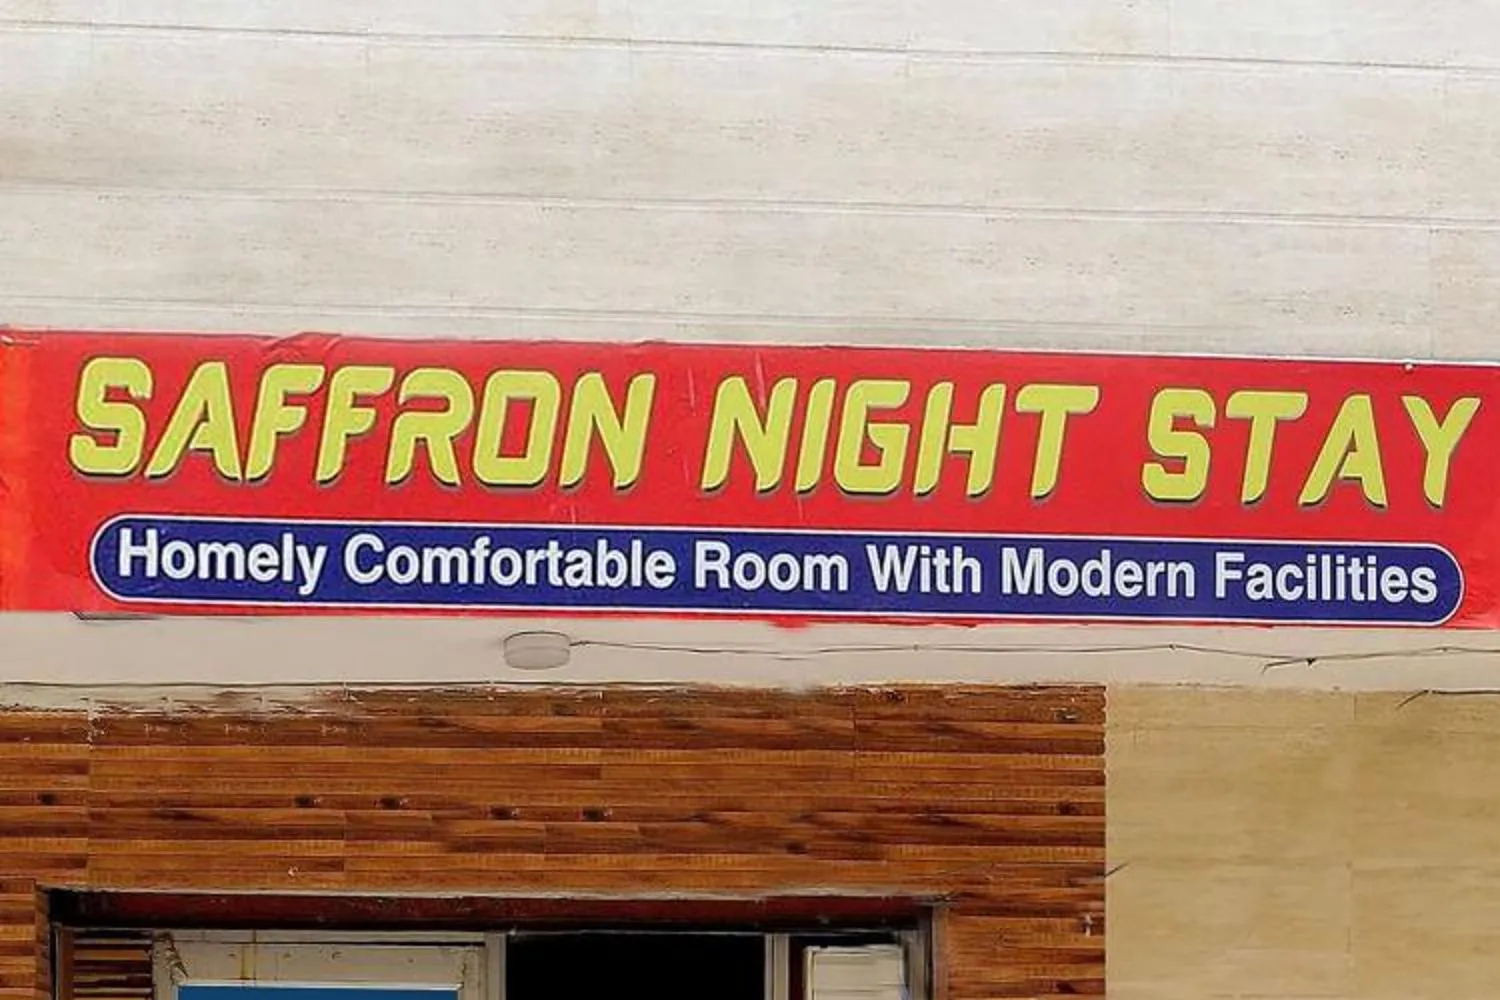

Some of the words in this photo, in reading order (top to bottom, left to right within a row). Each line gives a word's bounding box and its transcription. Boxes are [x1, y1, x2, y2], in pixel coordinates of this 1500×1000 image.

[69, 356, 656, 488] SAFFRON
[701, 377, 1099, 499] NIGHT
[1141, 388, 1481, 508] STAY
[117, 526, 328, 596] Homely
[343, 532, 677, 589] Comfortable
[694, 541, 850, 593] Room
[864, 544, 982, 594] With
[1000, 546, 1197, 599] Modern
[1214, 550, 1439, 604] Facilities
